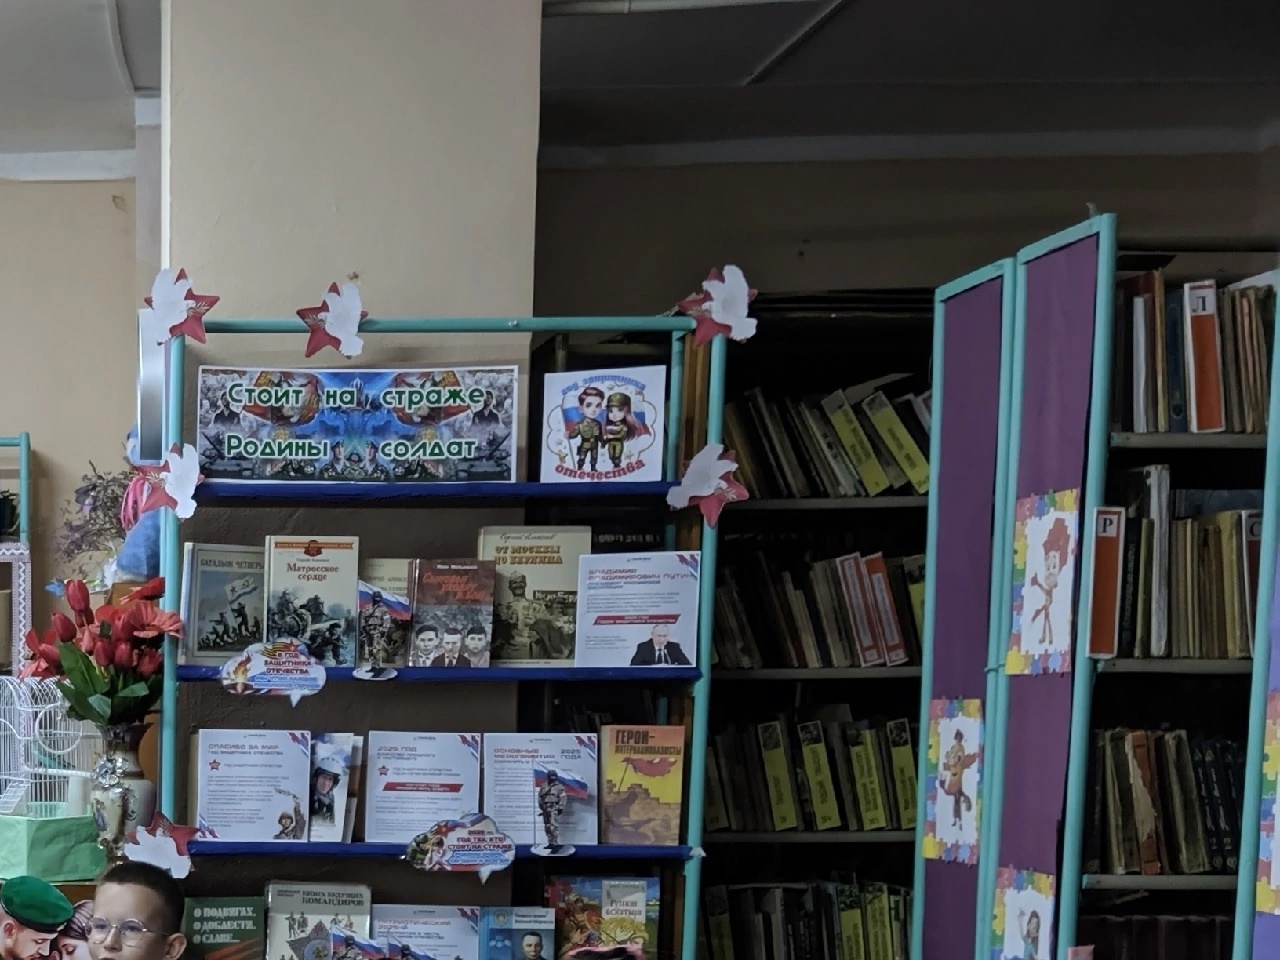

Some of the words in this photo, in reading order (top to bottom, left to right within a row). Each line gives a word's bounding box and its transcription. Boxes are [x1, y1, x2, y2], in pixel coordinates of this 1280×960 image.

[227, 382, 305, 407] Стоит
[325, 386, 355, 406] на
[381, 387, 485, 411] страже
[226, 434, 328, 459] Родины
[380, 439, 477, 459] солдат
[287, 563, 340, 573] Матросское
[298, 573, 327, 581] сердце
